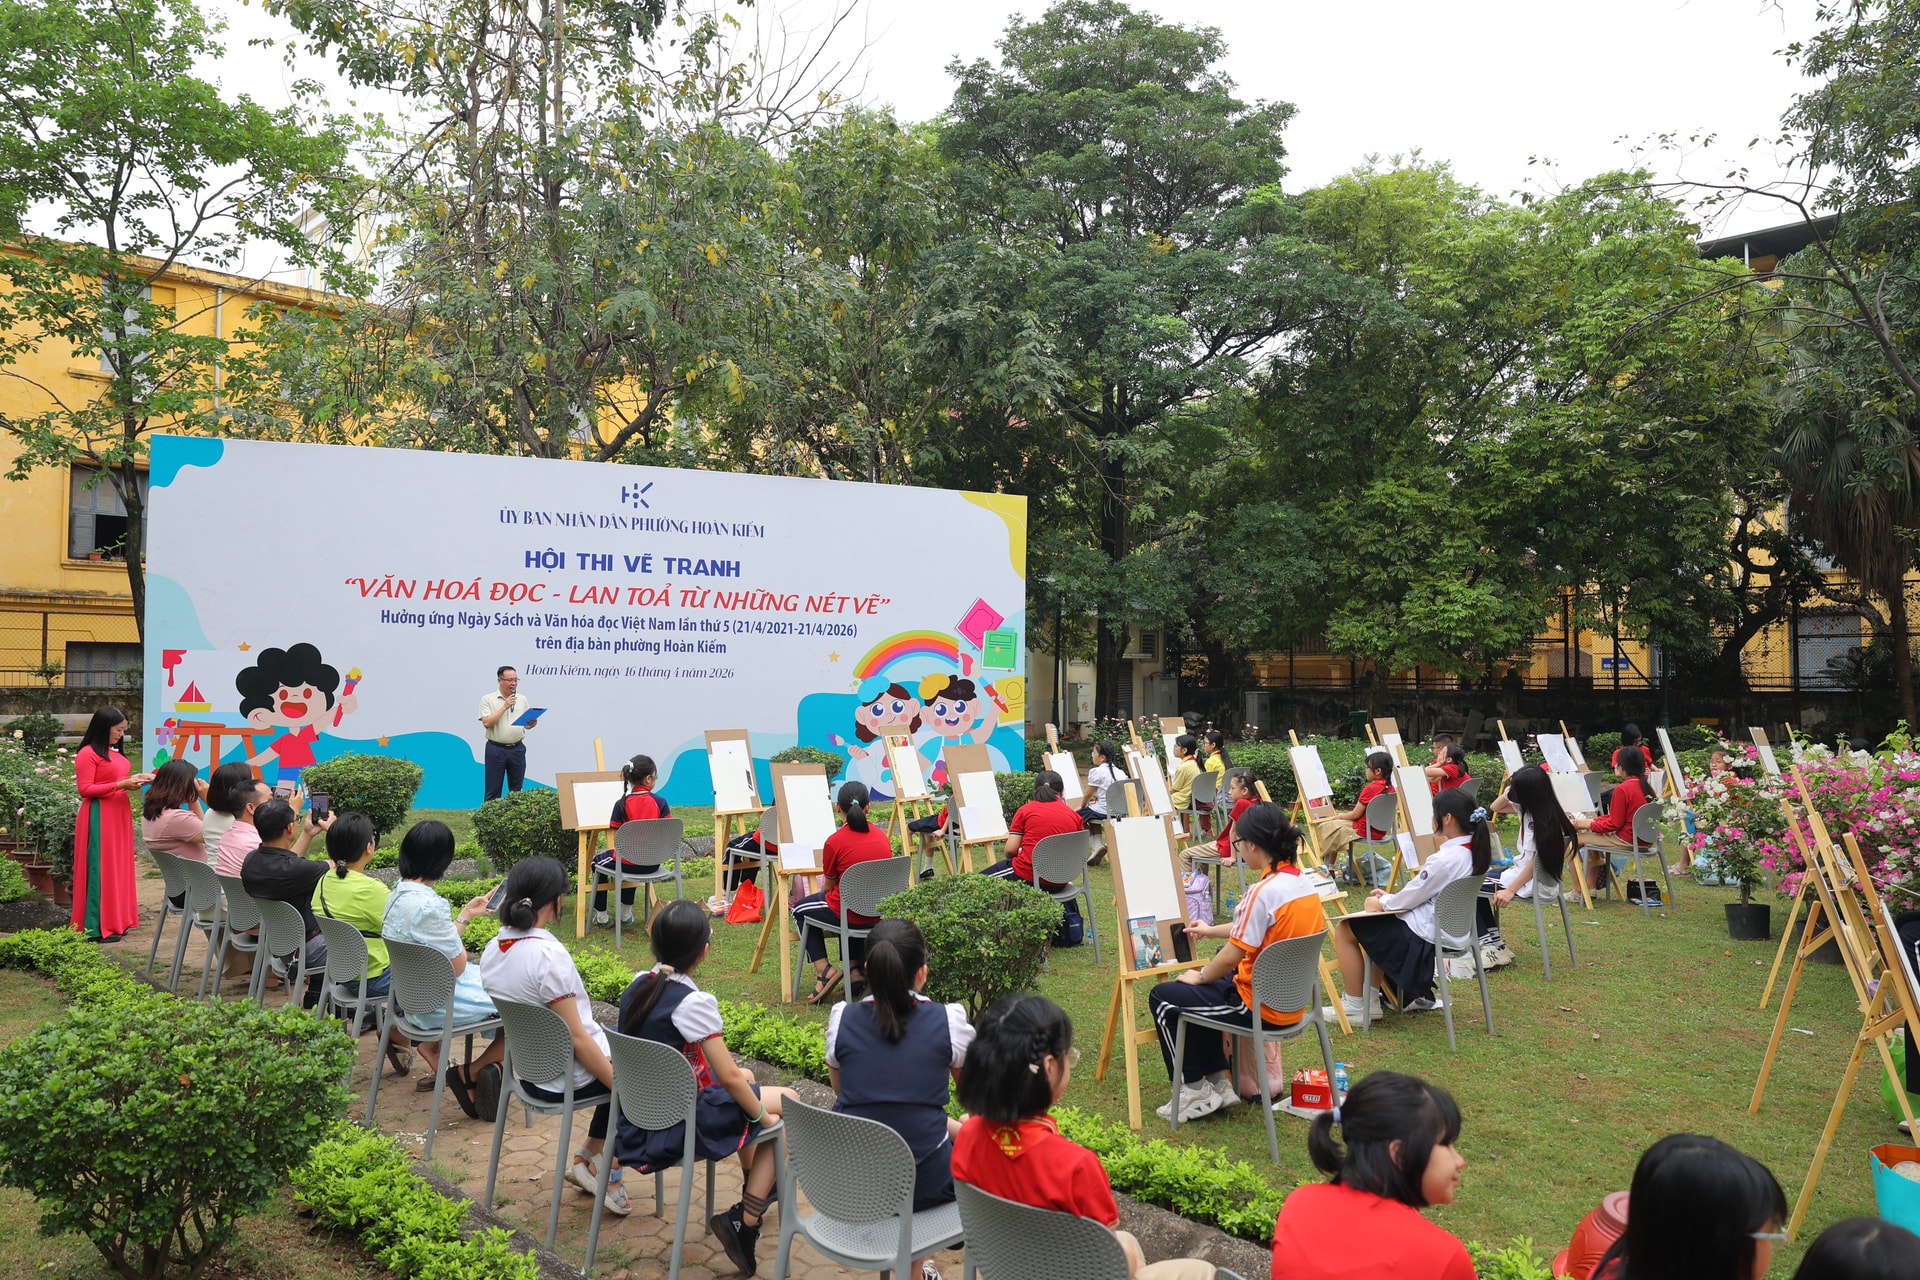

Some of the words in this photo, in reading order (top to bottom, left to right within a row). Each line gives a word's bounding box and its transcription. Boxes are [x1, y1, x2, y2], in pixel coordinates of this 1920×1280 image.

[499, 506, 521, 524] ỦY
[523, 510, 551, 526] BAN
[555, 511, 596, 528] NHÂN
[599, 513, 628, 530] DÂN
[631, 516, 689, 534] PHƯỜNG
[692, 520, 729, 536] HOÀN
[732, 520, 765, 538] KIẾM
[524, 547, 566, 574] HỘI
[576, 552, 614, 572] THI
[623, 552, 653, 574] VẼ
[662, 556, 741, 578] TRANH
[422, 576, 481, 601] HOÁ
[489, 581, 546, 606] ĐỌC
[568, 584, 621, 605] LAN
[627, 582, 671, 607] TOẢ
[679, 585, 711, 609] TỪ
[713, 588, 800, 613] NHỮNG
[804, 591, 851, 614] NÉT
[380, 608, 426, 628] Hưởng
[428, 610, 455, 629] ứng
[458, 612, 492, 630] Ngày
[493, 612, 524, 627] Sách
[526, 613, 542, 627] và
[544, 613, 568, 628] Văn
[571, 613, 595, 629] hóa
[597, 614, 619, 632] đọc
[620, 615, 646, 633] Việt
[648, 616, 676, 631] Nam
[678, 616, 697, 632] lần
[699, 618, 721, 633] thứ
[722, 619, 730, 633] 5
[732, 619, 858, 638] (21/4/2021-21/4/2026)
[535, 636, 562, 650] trên
[565, 636, 585, 653] địa
[587, 636, 611, 651] bàn
[613, 637, 661, 655] phường
[663, 638, 695, 653] Hoàn
[697, 639, 727, 654] Kiếm
[525, 664, 558, 676] Hoàn
[559, 664, 591, 677] Kiếm,
[594, 666, 621, 679] ngày
[624, 666, 636, 677] 16
[637, 666, 671, 680] tháng
[682, 668, 707, 678] năm
[708, 668, 735, 679] 2026
